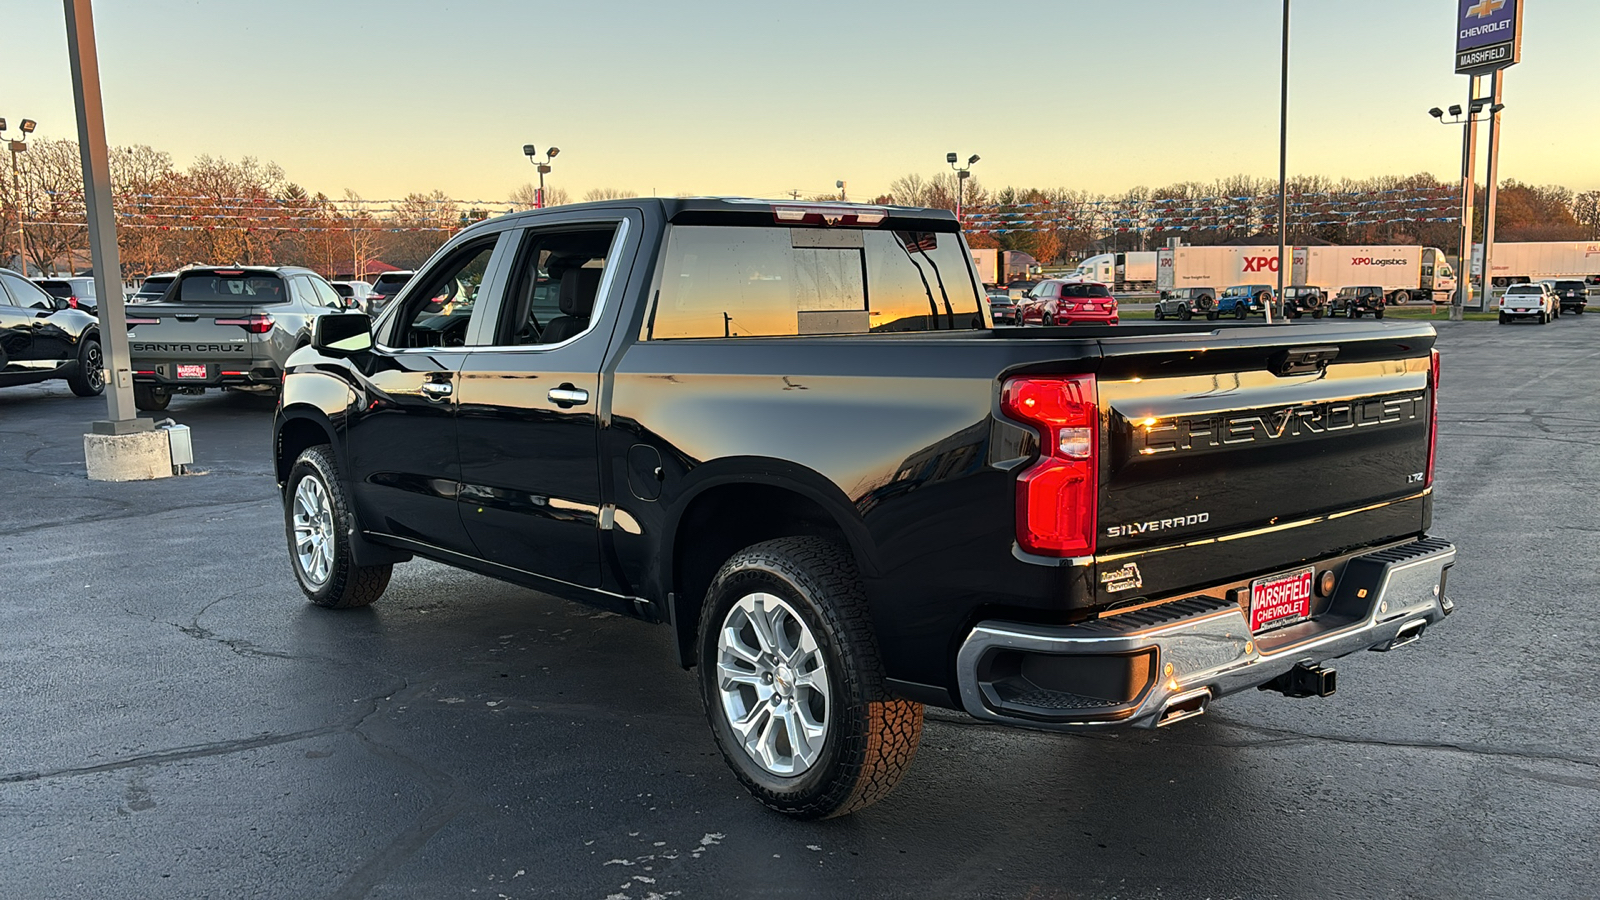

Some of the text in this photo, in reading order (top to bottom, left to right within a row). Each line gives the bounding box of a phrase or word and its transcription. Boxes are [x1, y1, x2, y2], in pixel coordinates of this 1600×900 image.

[1460, 19, 1511, 39] CHEVROLET
[1460, 47, 1505, 66] MARSHFIELD
[1160, 258, 1172, 267] XPO
[1242, 256, 1279, 272] XPO
[133, 344, 245, 352] SANTA CRUZ
[1139, 397, 1423, 455] CHEVROLET
[1406, 472, 1423, 484] LTZ
[1106, 512, 1209, 538] SILVERADO
[1106, 579, 1136, 592] Chevrolet
[1253, 579, 1311, 611] MARSHFIELD
[1257, 600, 1304, 622] CHEVROLET
